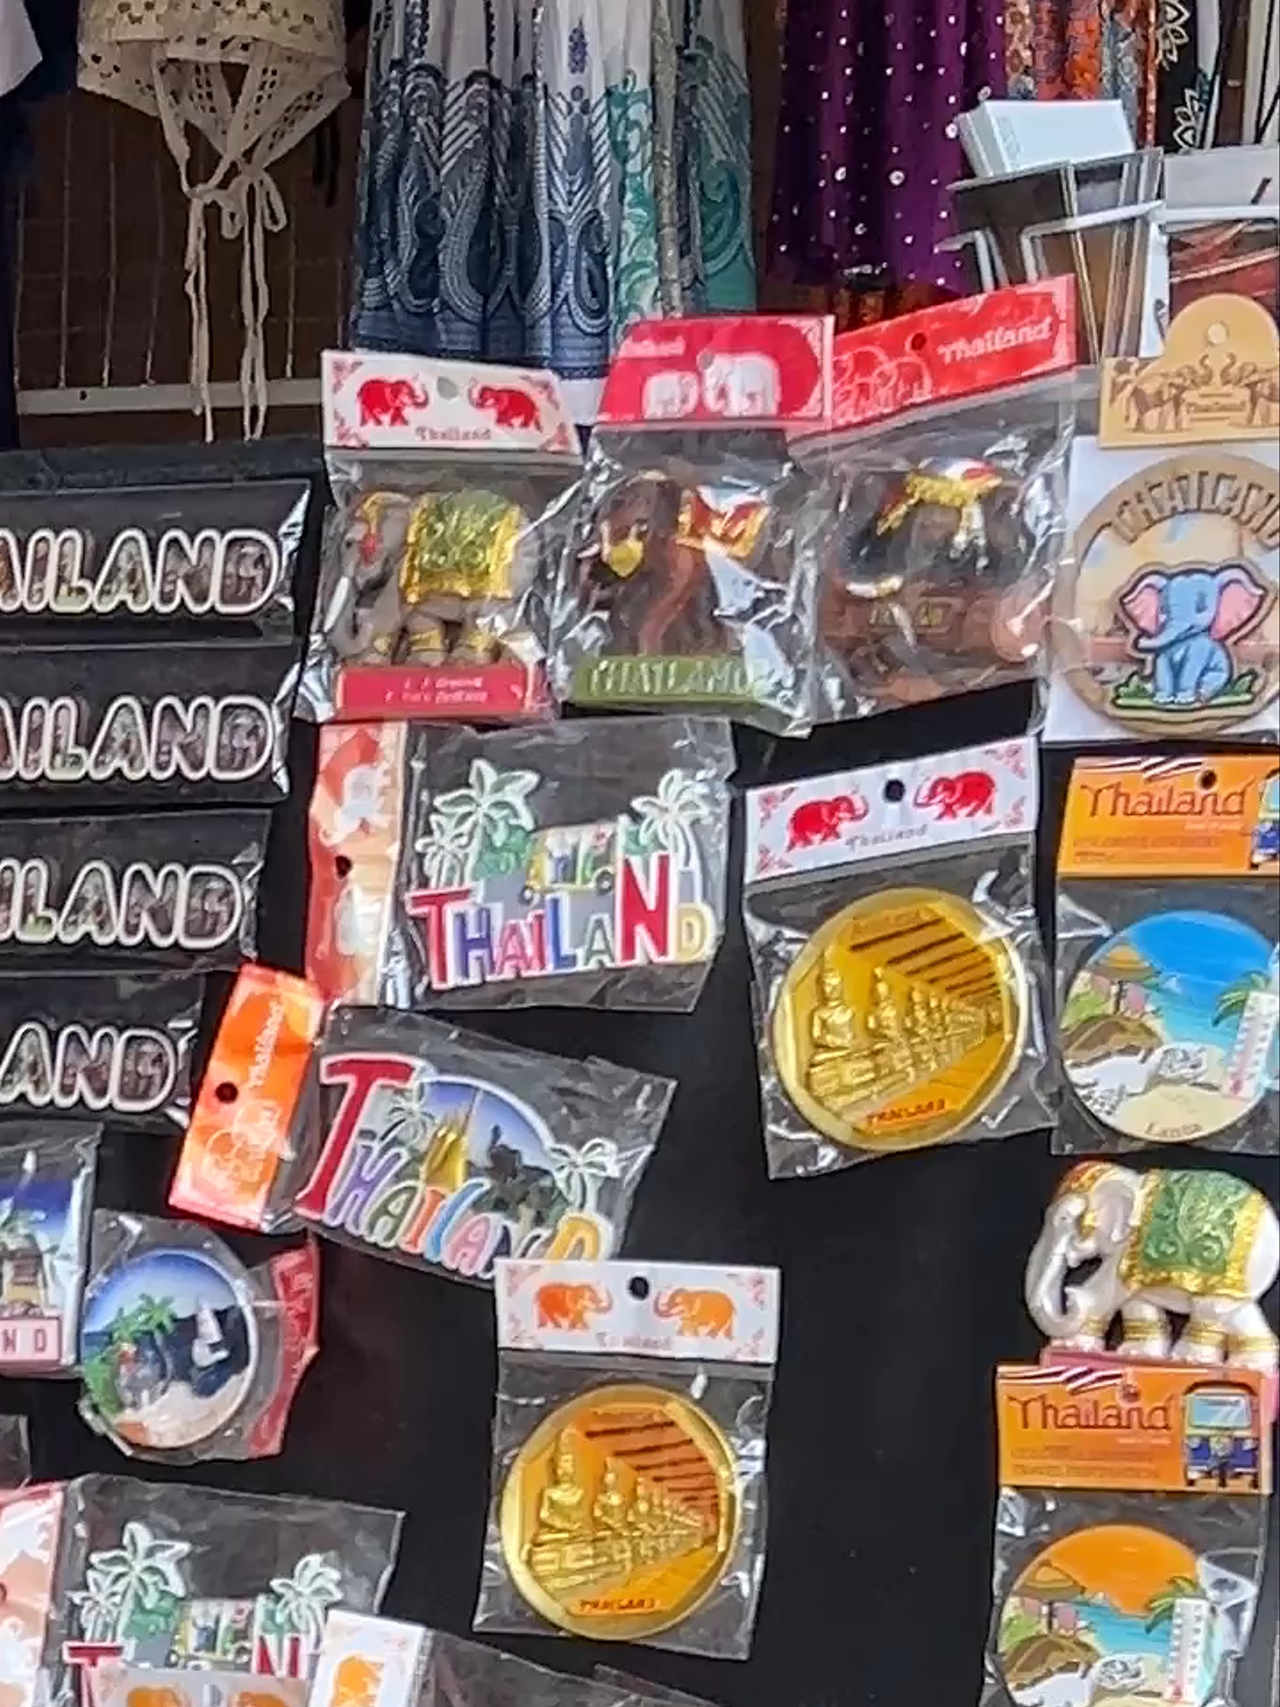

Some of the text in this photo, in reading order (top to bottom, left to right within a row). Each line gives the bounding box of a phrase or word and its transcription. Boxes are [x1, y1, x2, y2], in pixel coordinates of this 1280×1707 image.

[1079, 778, 1257, 817] Thailand
[405, 850, 716, 991] THAILAND
[1007, 1393, 1175, 1431] Thailand
